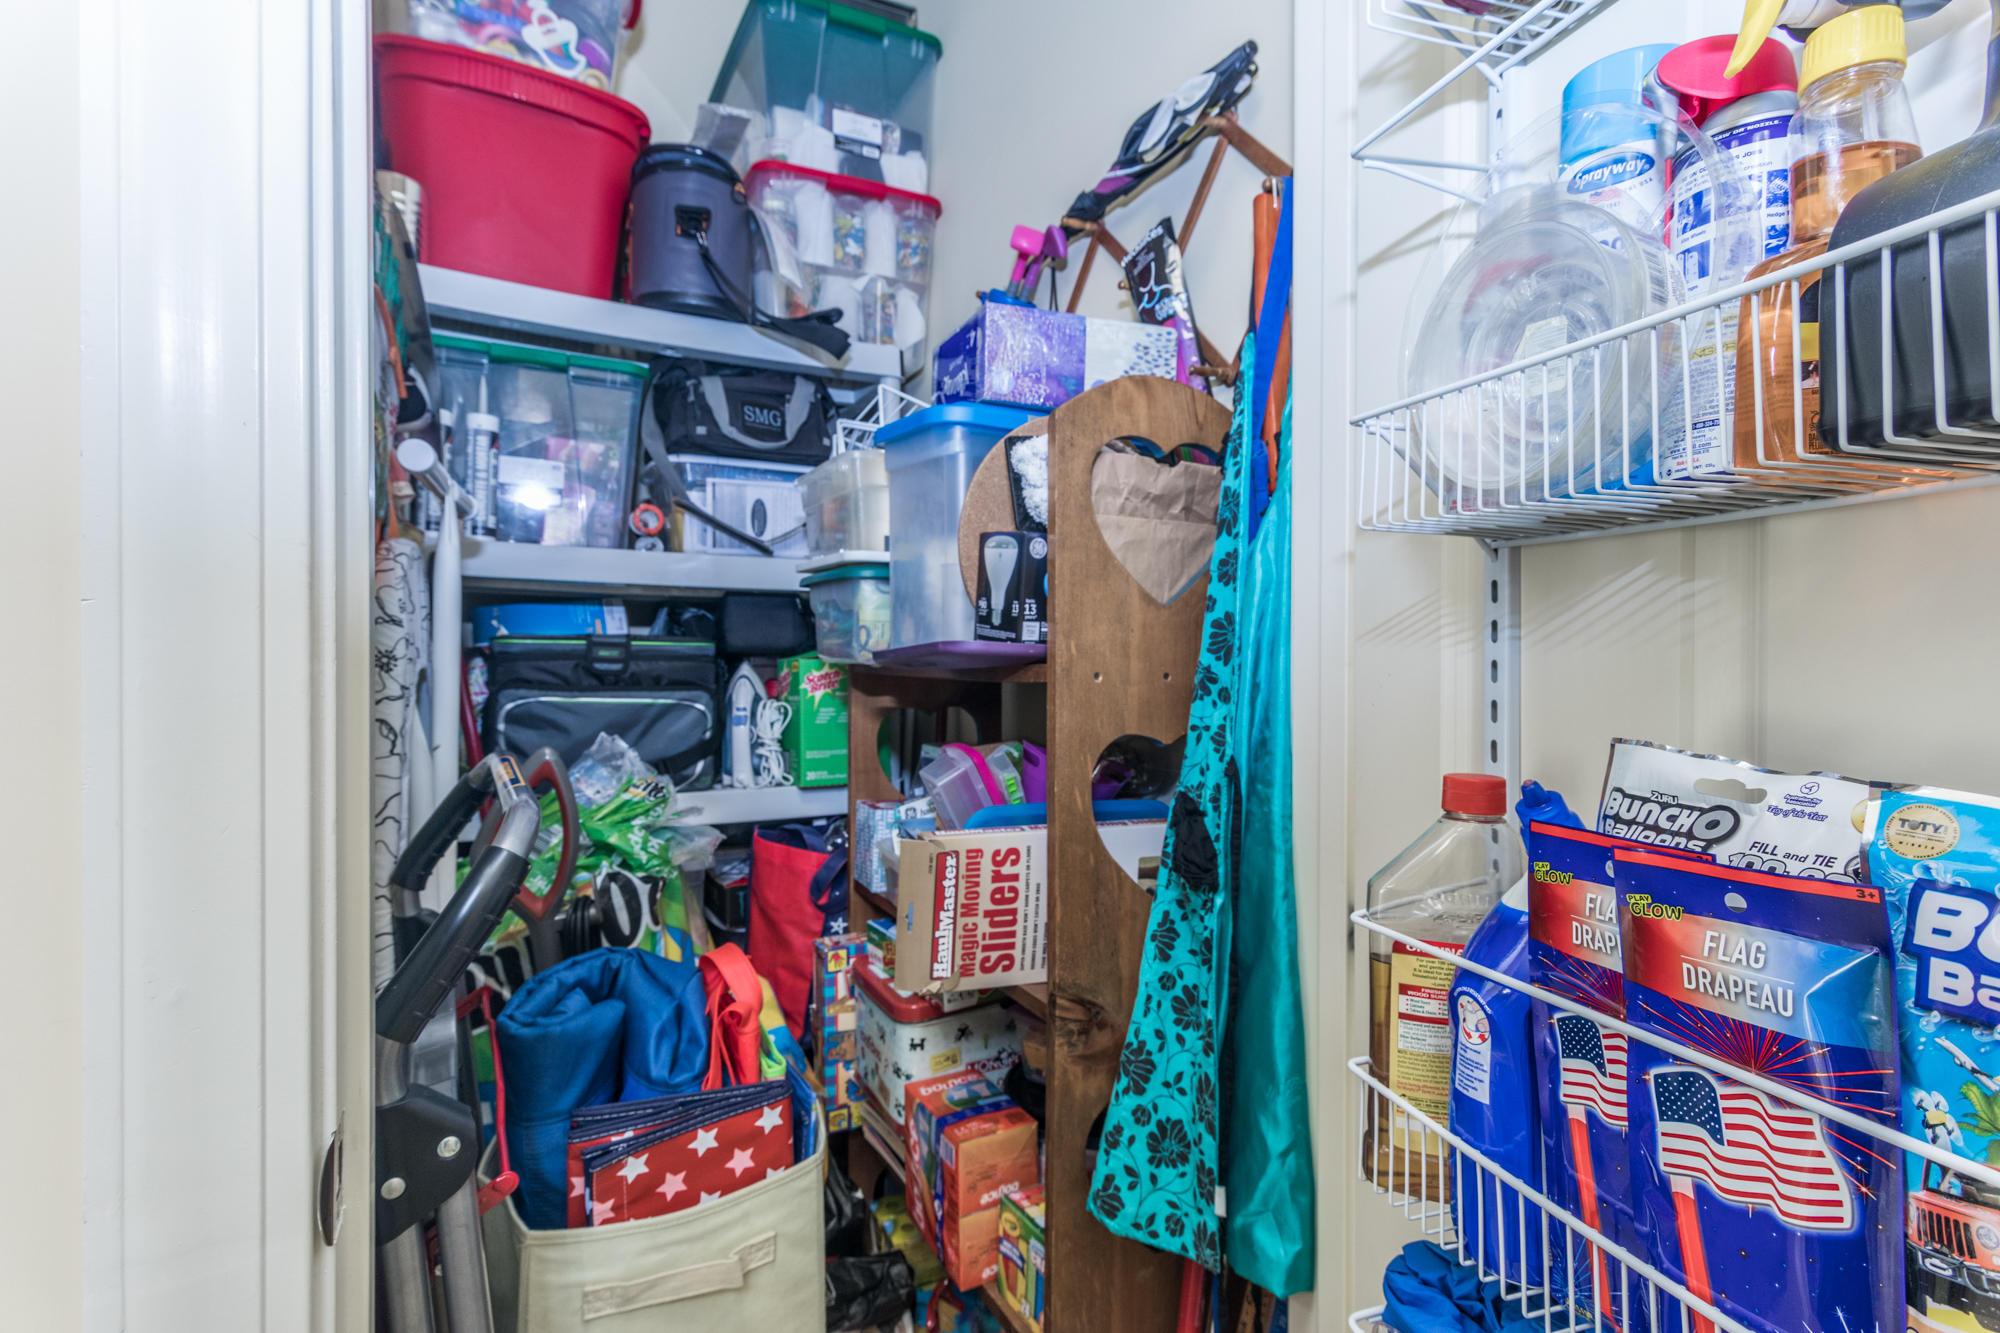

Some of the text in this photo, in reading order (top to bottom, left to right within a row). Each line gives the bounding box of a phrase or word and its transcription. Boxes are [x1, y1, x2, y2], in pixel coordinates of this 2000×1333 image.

[1573, 156, 1647, 190] Sprayway
[743, 404, 782, 428] SMG
[1024, 604, 1037, 615] 13
[1650, 791, 1679, 805] ZURU
[1766, 805, 1783, 816] Toy
[1807, 811, 1829, 822] Year
[1604, 817, 1709, 852] Balloons
[1534, 862, 1549, 870] PLAY
[1748, 841, 1838, 868] FILL and TIE
[1534, 869, 1573, 885] GLOW
[1627, 894, 1650, 903] PLAY
[1856, 888, 1876, 901] 3+
[932, 851, 958, 978] HaulMaster
[958, 848, 984, 978] Magic Moving
[979, 847, 1021, 974] Sliders
[1585, 893, 1617, 924] FLA
[1631, 902, 1682, 921] GLOW
[1572, 921, 1622, 958] DRAP
[1703, 930, 1767, 970] FLAG
[1408, 990, 1430, 998] WOOD
[1682, 962, 1794, 1018] DRAPEAU
[919, 1073, 980, 1097] bounce
